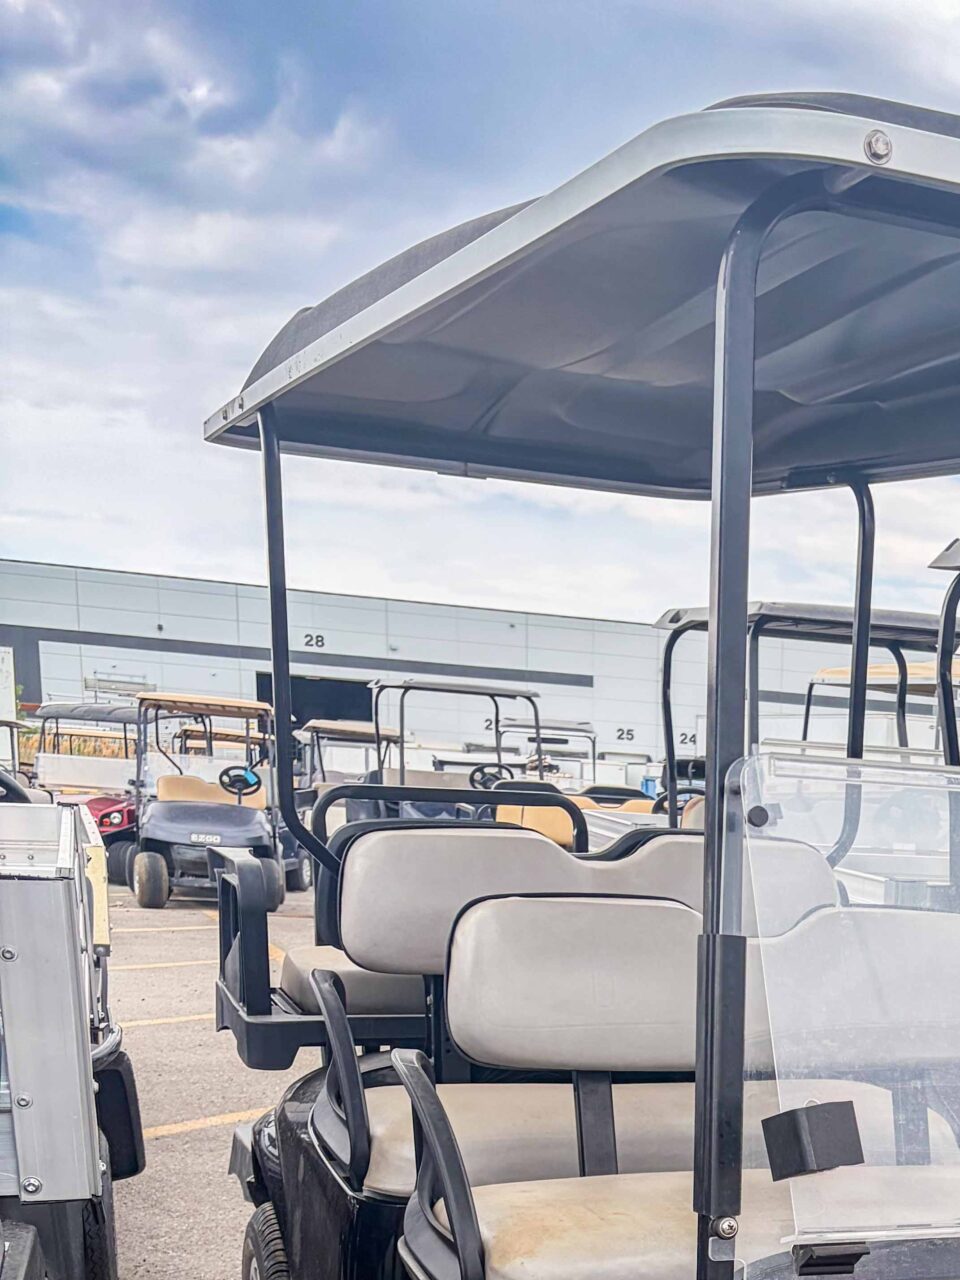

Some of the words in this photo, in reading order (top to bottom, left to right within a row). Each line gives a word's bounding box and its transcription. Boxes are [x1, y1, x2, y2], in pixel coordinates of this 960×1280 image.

[303, 633, 325, 648] 28
[616, 728, 635, 741] 25
[679, 732, 697, 746] 24
